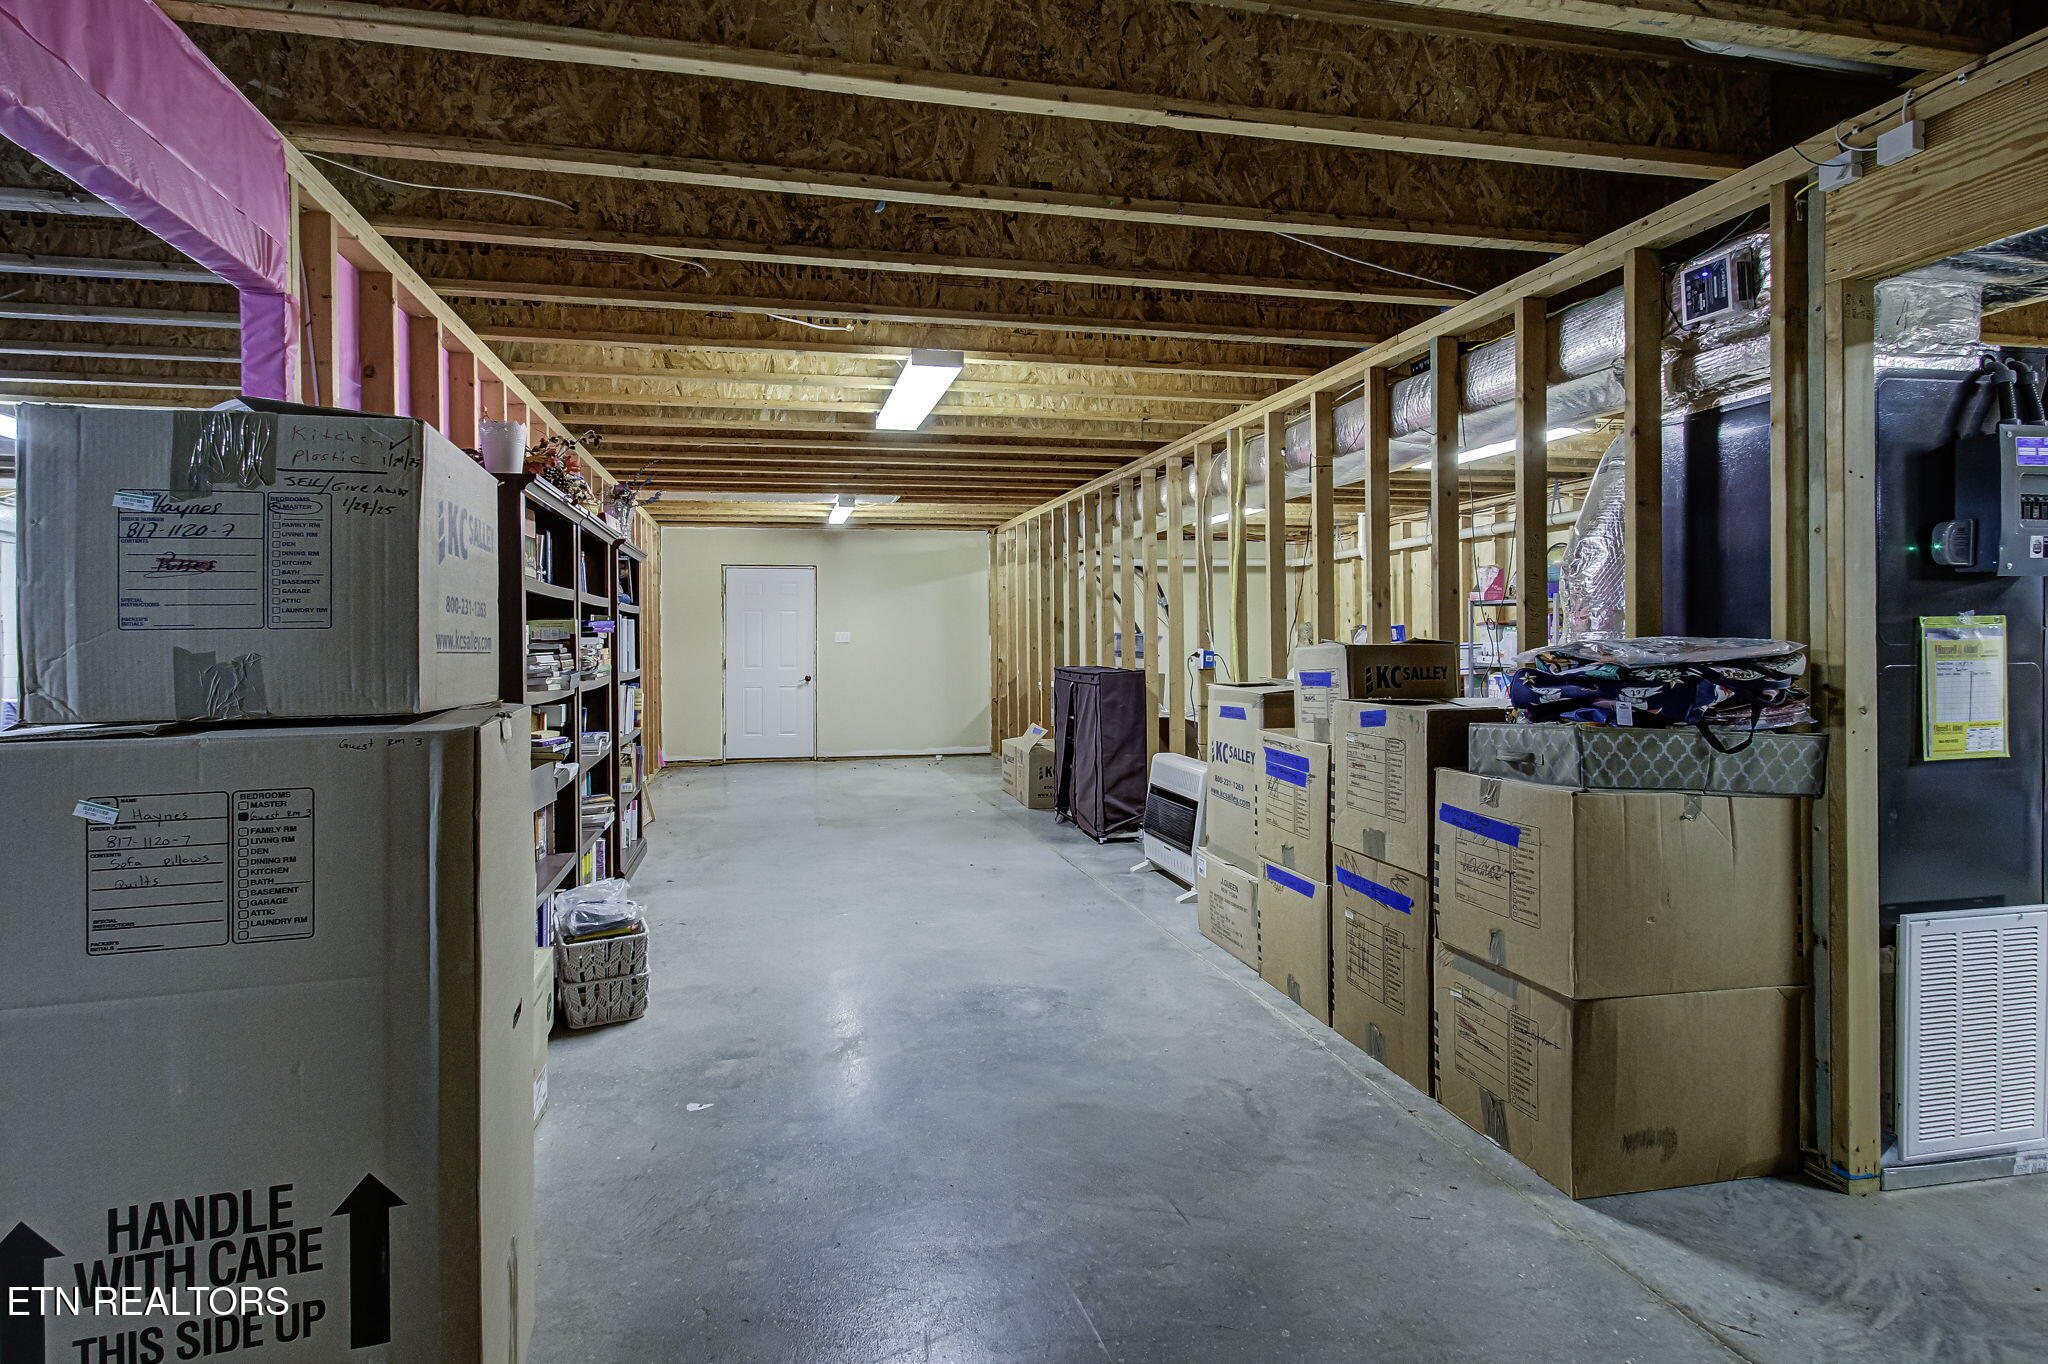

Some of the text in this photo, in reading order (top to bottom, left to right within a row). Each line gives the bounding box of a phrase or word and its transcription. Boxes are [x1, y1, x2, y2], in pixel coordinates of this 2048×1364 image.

[153, 494, 222, 518] Haynes
[448, 501, 468, 561] KC
[436, 629, 492, 652] www.kcsalley.com
[1376, 665, 1448, 689] KC SALLEY
[1216, 740, 1229, 764] KC
[1229, 745, 1256, 765] SALLEY
[240, 791, 291, 800] BEDROOMS
[132, 808, 189, 827] Haynes
[107, 835, 191, 848] 817-1120-7
[250, 857, 281, 865] DINING
[250, 867, 289, 875] KITCHEN
[250, 878, 274, 886] BATH
[250, 887, 299, 896] BASEMENT
[250, 898, 289, 906] GARAGE
[250, 909, 276, 917] ATTIC
[250, 918, 292, 927] LAUNDRY
[107, 1183, 294, 1255] HANDLE
[74, 1226, 323, 1309] WITH CARE
[72, 1299, 326, 1364] THIS SIDE UP
